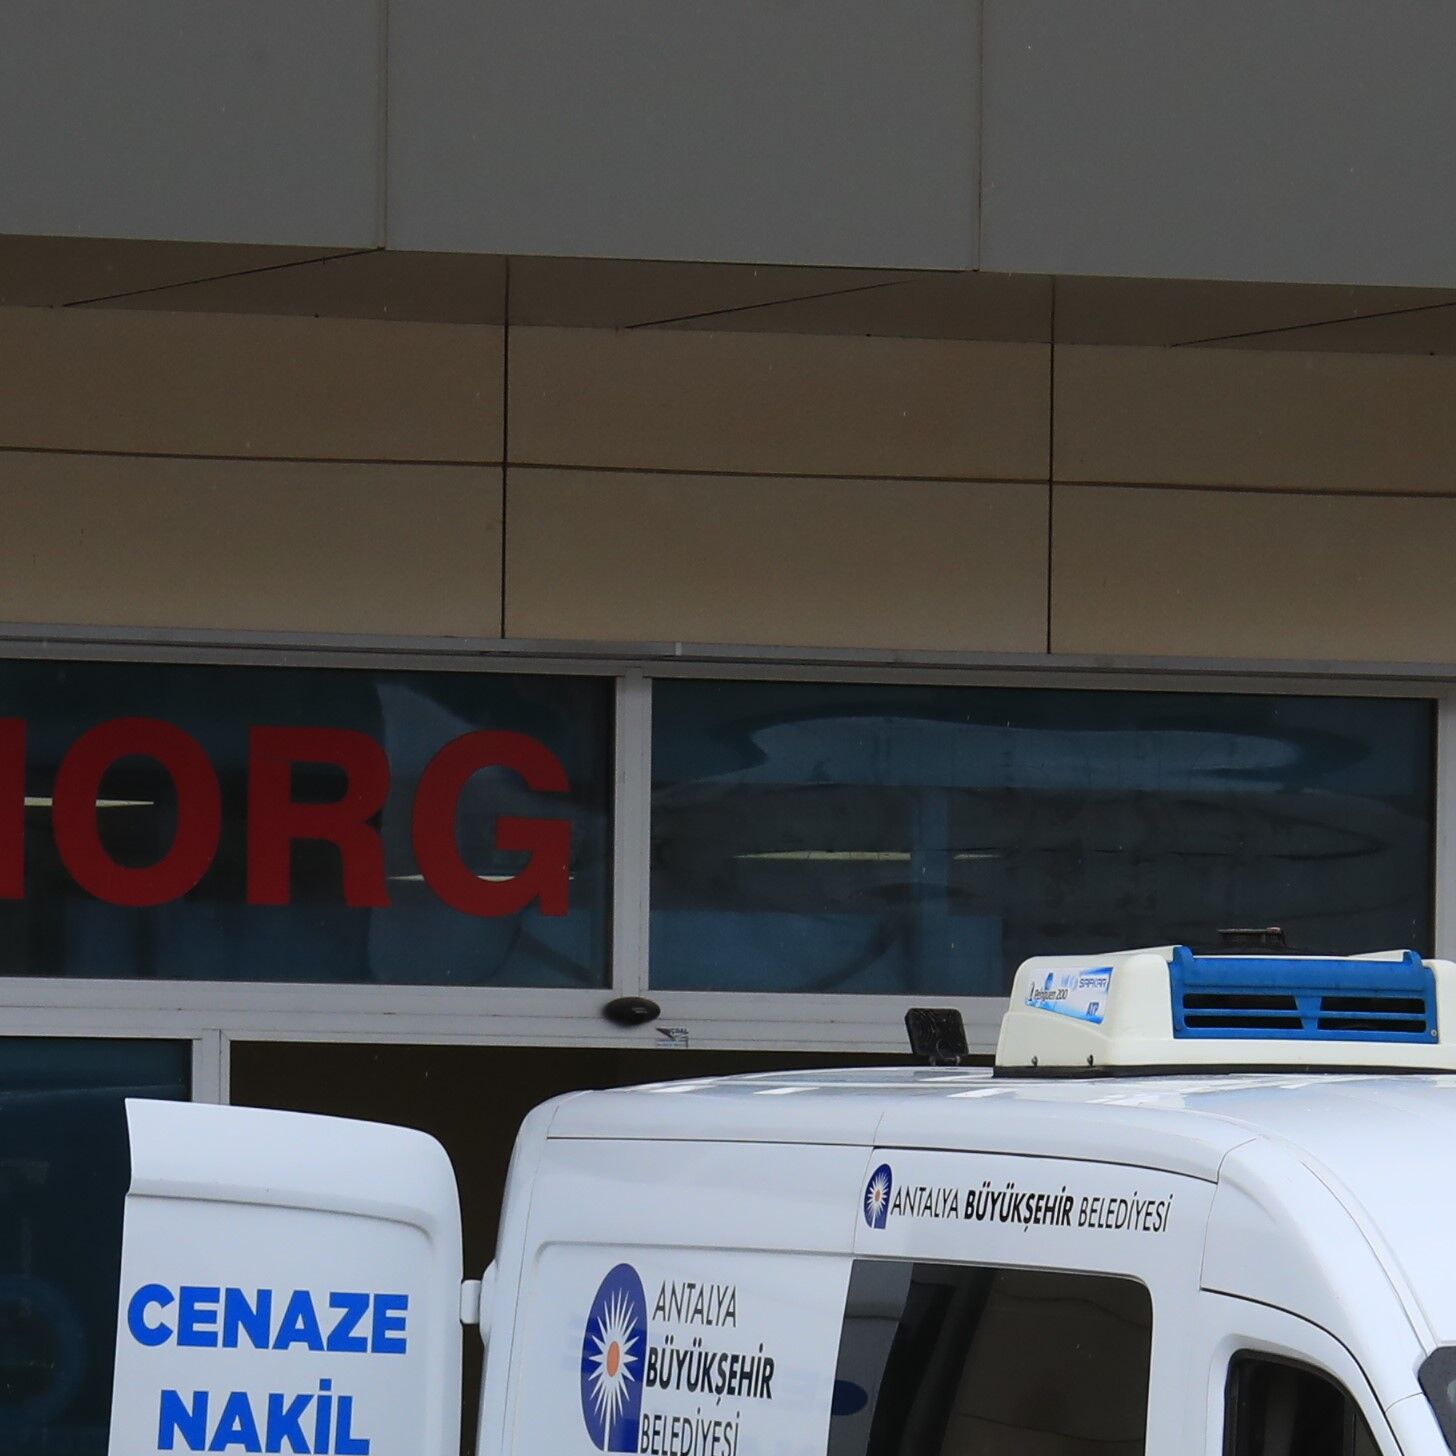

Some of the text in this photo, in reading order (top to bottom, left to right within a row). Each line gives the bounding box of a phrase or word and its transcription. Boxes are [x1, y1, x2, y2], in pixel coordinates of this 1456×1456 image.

[1056, 988, 1068, 1000] 200
[890, 1181, 1174, 1233] ANTALYA BÜYÜKŞEHİR BELEDİYESİ
[127, 1283, 409, 1354] CENAZE
[653, 1280, 737, 1328] ANTALYA
[646, 1335, 775, 1407] BÜYÜKŞEHİR
[157, 1378, 370, 1456] NAKİL
